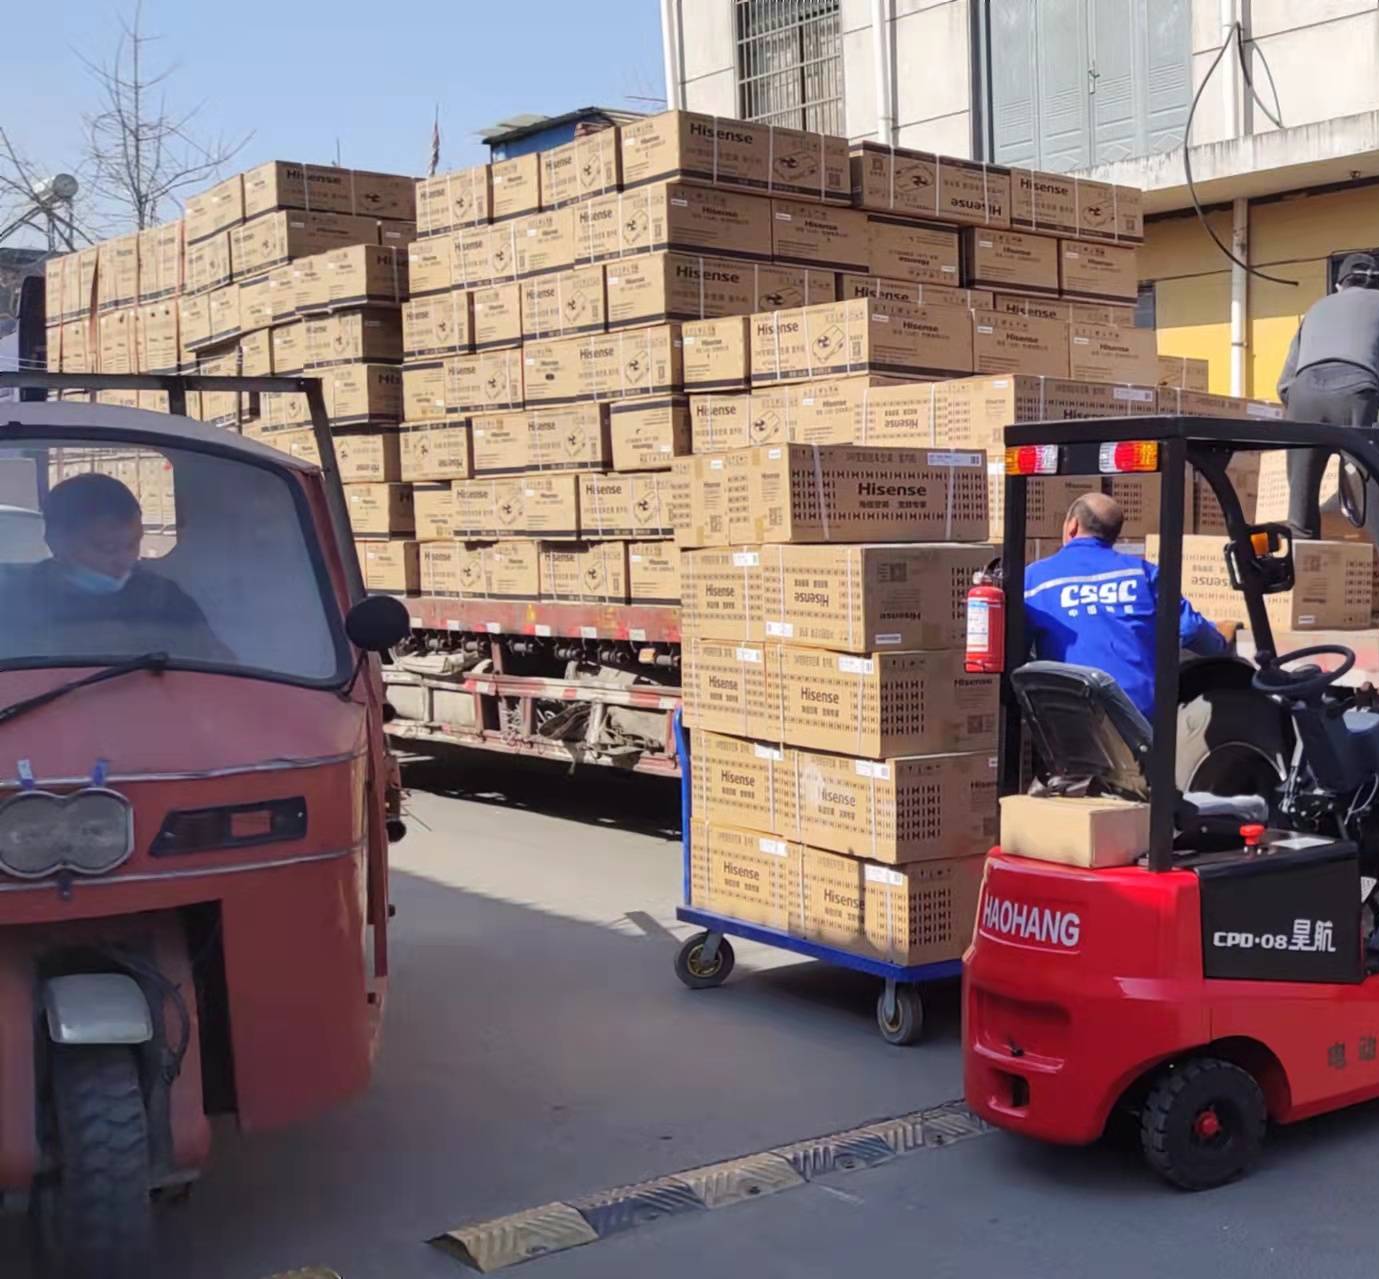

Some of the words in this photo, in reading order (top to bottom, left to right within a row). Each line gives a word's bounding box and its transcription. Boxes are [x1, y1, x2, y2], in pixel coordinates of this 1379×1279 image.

[689, 122, 753, 145] Hisense
[676, 265, 740, 284] Hisense
[757, 321, 799, 336] Hisnse
[902, 320, 939, 333] Hisense
[858, 482, 927, 497] Hisense
[706, 584, 735, 598] Hisense
[794, 591, 829, 607] Hisense
[1061, 580, 1136, 608] CSSC
[709, 675, 738, 691] Hisense
[801, 686, 839, 704] Hisense
[721, 769, 755, 788] Hisense
[723, 861, 760, 881] Hisense
[824, 888, 865, 911] Hisense
[983, 895, 1080, 946] HAOHANG
